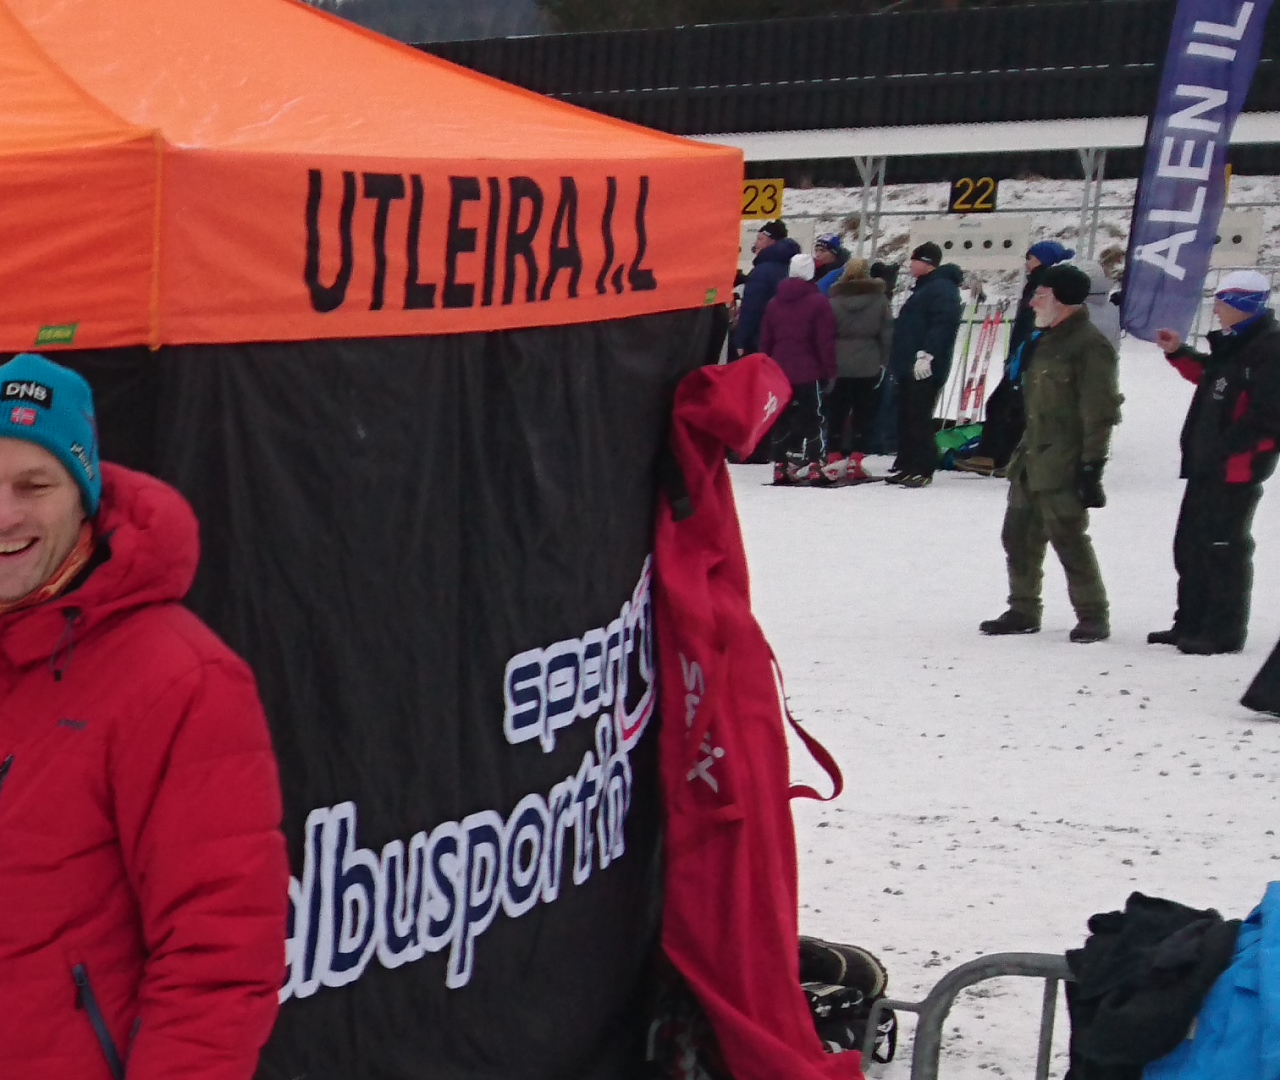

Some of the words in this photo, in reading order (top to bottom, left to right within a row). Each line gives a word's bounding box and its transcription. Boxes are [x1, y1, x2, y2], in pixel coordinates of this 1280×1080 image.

[1133, 84, 1229, 282] ÅLEN
[1186, 2, 1256, 62] IL
[741, 183, 779, 216] 23
[952, 177, 996, 211] 22
[303, 168, 583, 314] UTLEIRA
[5, 381, 48, 401] DNB
